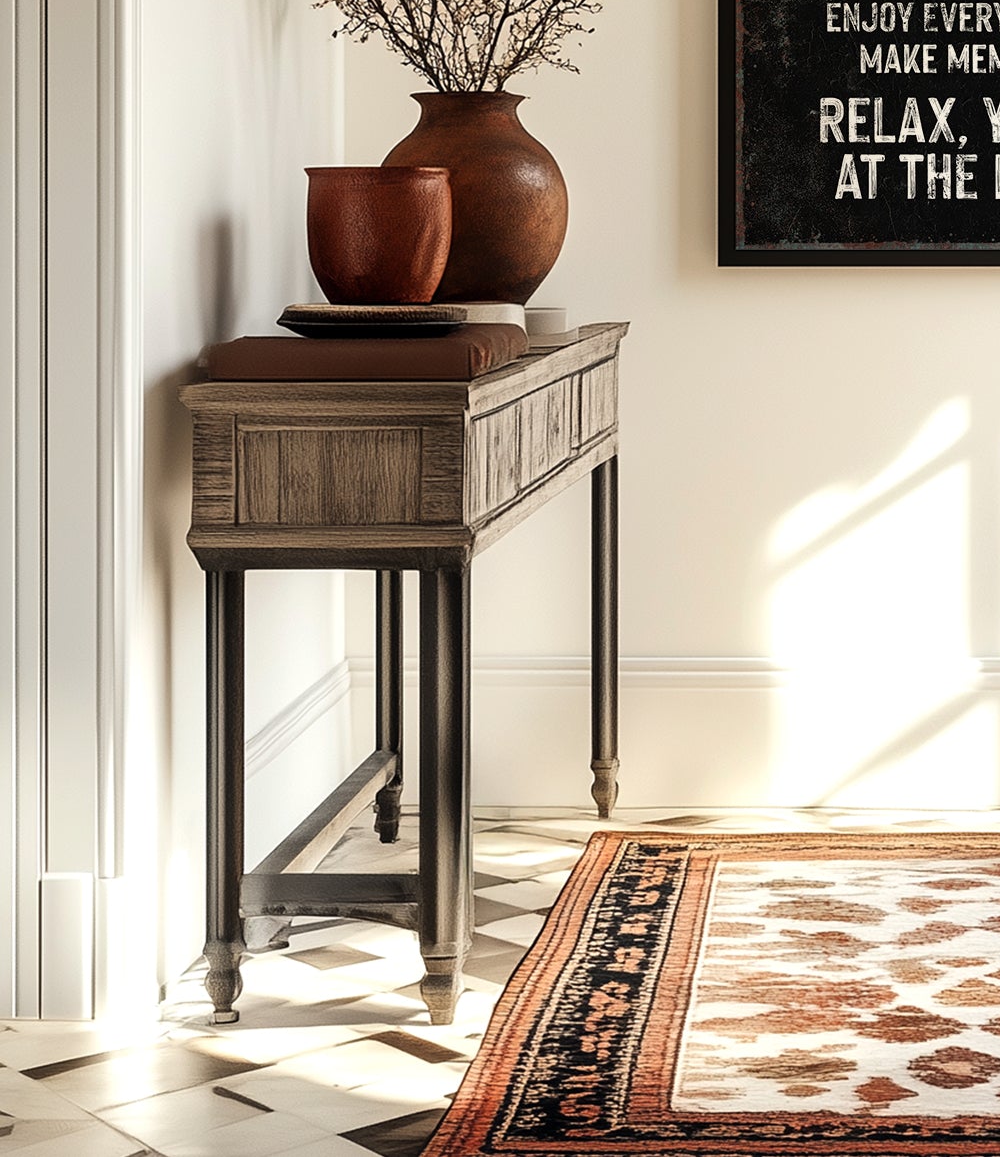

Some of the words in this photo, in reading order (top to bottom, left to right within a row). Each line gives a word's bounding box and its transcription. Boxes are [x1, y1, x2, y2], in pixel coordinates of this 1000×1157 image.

[826, 2, 915, 33] ENJOY
[860, 43, 938, 74] MAKE
[819, 97, 968, 150] RELAX,
[834, 153, 886, 200] AT
[898, 153, 978, 200] THE
